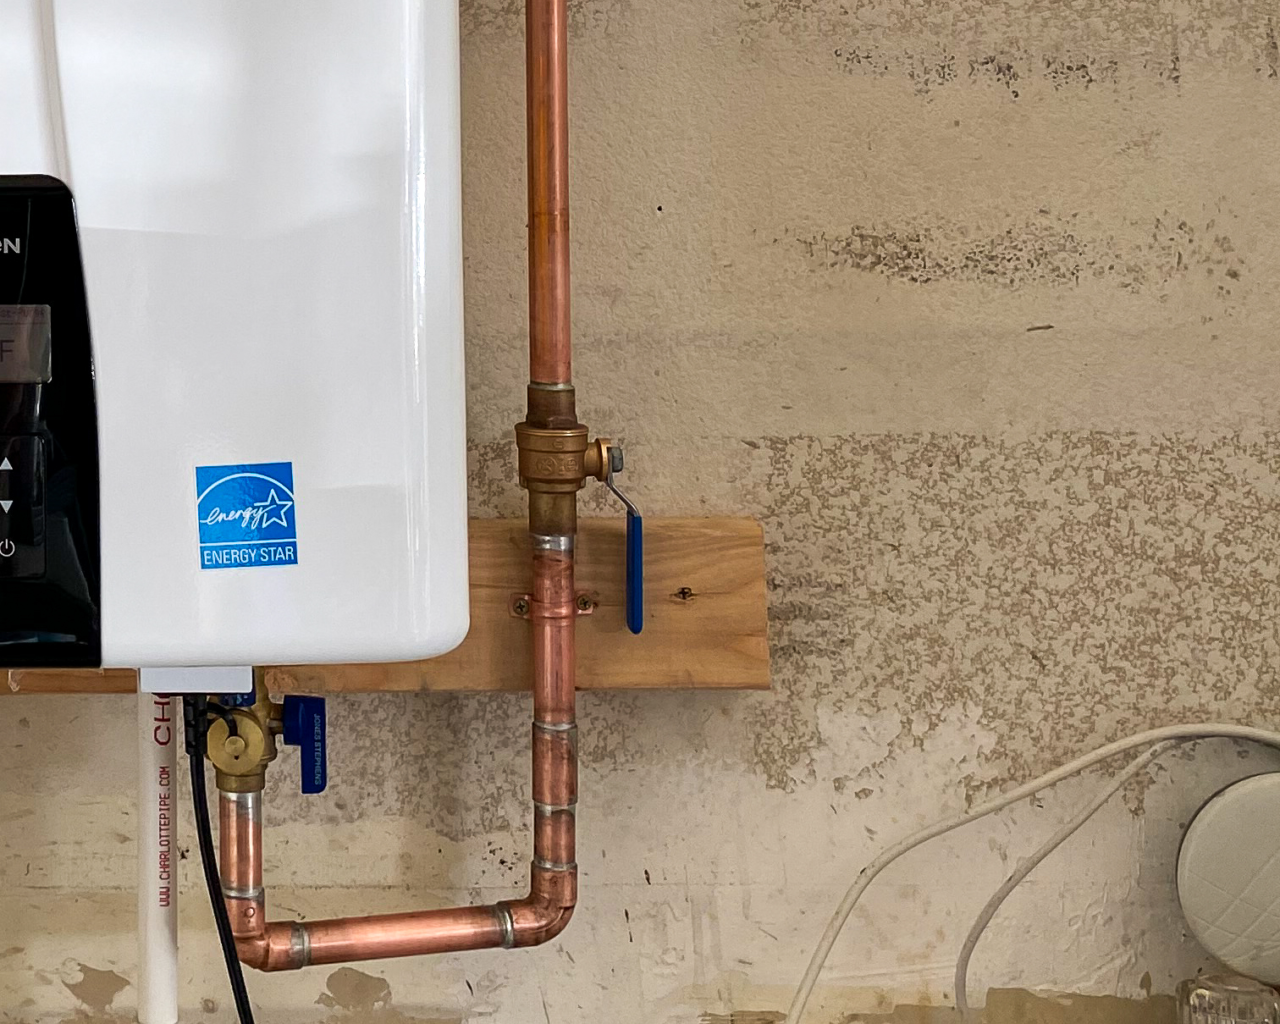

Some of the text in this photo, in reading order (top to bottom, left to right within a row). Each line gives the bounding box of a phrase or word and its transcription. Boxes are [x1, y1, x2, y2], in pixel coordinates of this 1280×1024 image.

[200, 505, 276, 529] energy
[203, 546, 295, 565] ENERGY STAR
[153, 693, 171, 746] CH
[313, 713, 322, 785] JONES STEPHENS
[158, 765, 171, 908] WWW.CHARLOTTEPIPE.COM
